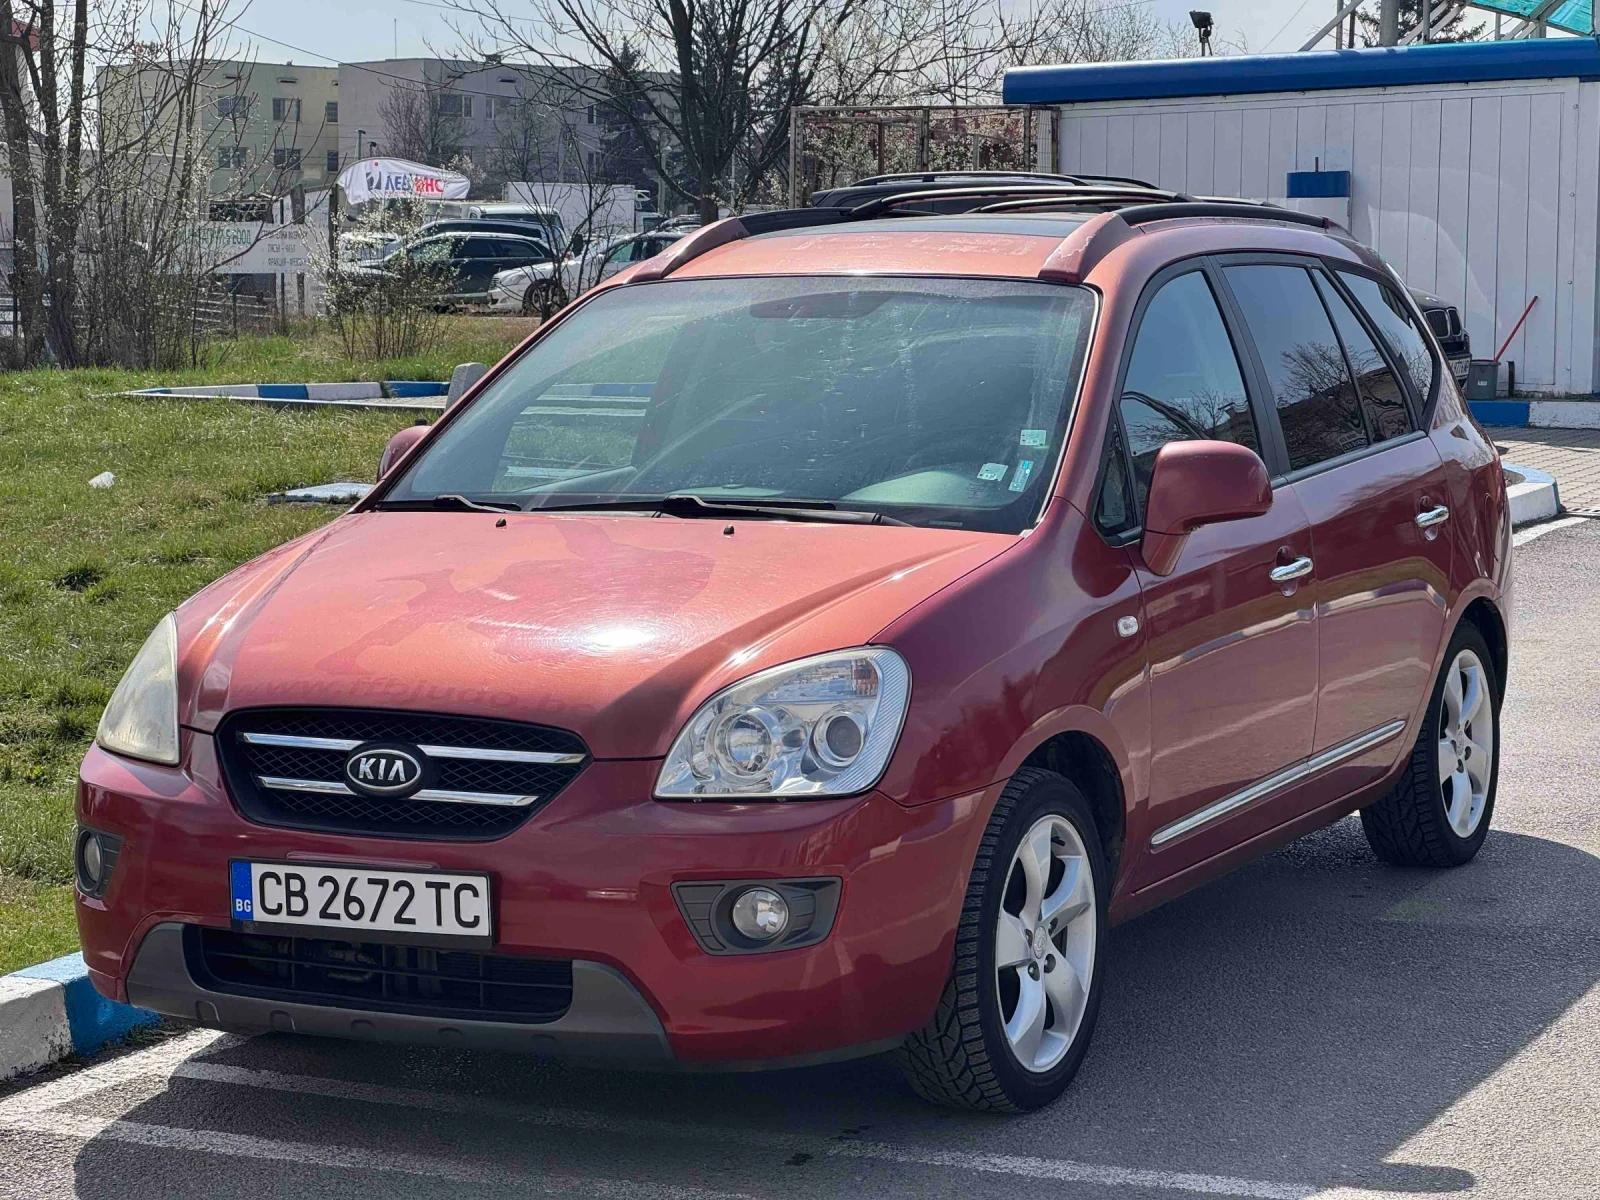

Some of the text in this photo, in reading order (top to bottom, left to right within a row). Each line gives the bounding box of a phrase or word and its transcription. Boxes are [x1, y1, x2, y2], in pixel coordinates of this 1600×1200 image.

[359, 757, 406, 782] KIA
[235, 898, 252, 912] BG
[258, 871, 480, 929] CB 2672 TC
